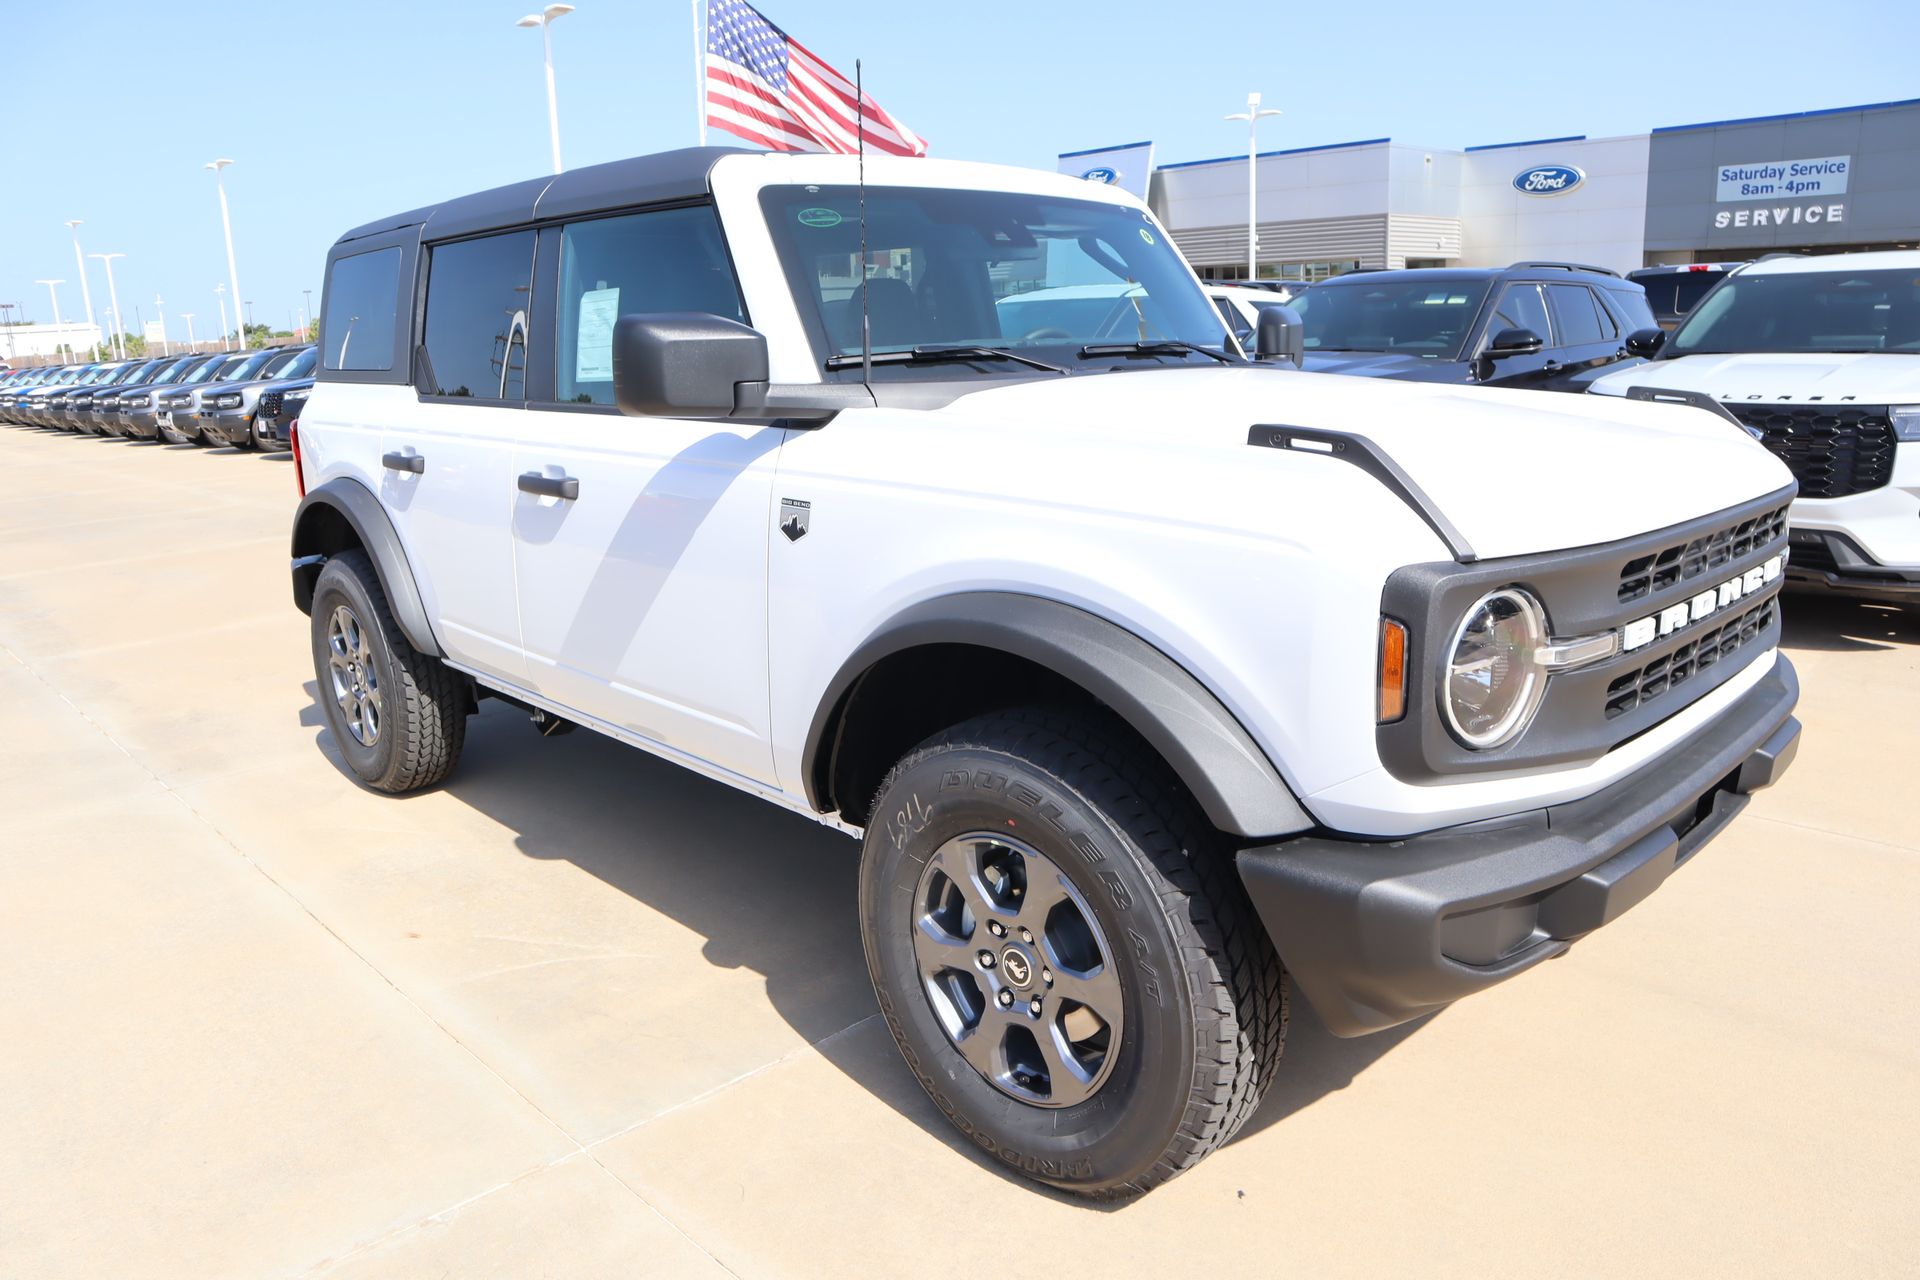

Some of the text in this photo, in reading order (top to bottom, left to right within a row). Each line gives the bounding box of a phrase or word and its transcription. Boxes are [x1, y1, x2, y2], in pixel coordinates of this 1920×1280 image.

[1525, 170, 1567, 190] Ford
[1721, 161, 1846, 182] Saturday Service
[1741, 183, 1774, 196] 8am
[1785, 180, 1821, 195] 4pm
[1715, 204, 1843, 228] SERVICE
[1623, 556, 1781, 650] BRONCO
[939, 768, 1135, 910] DUELER
